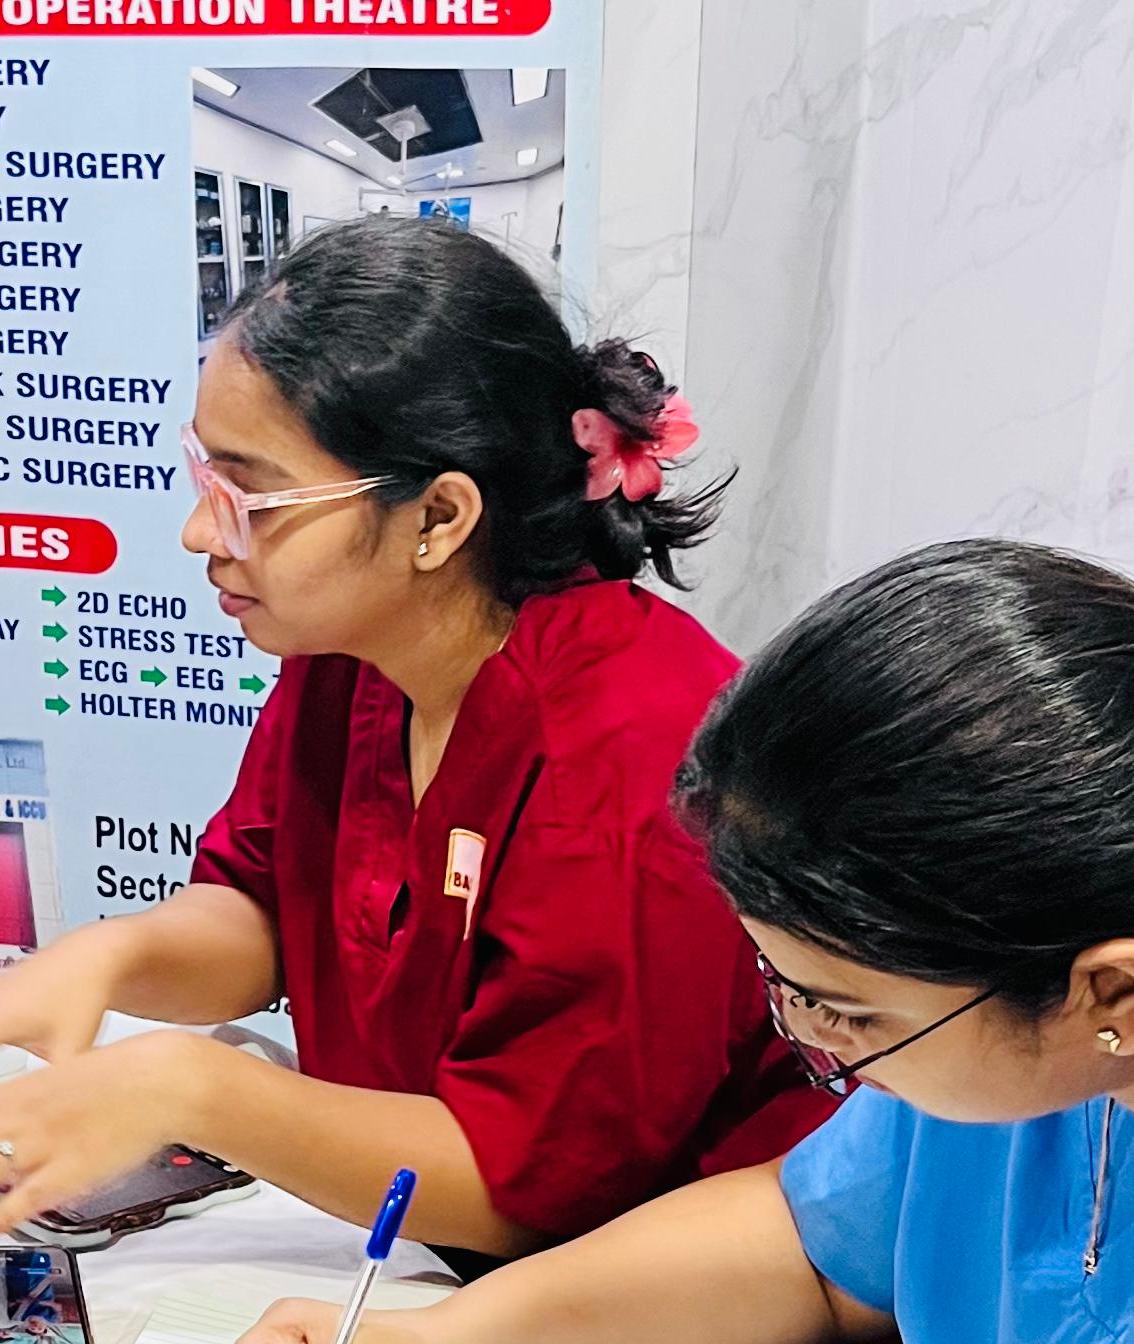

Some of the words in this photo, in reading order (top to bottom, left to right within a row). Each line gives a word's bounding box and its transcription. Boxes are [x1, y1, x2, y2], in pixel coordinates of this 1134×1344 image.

[5, 152, 166, 182] SURGERY
[16, 375, 171, 404] SURGERY
[5, 415, 161, 448] SURGERY
[22, 458, 176, 491] SURGERY
[77, 592, 108, 615] 2D
[119, 595, 186, 619] ECHO
[78, 626, 175, 653] STRESS
[184, 633, 246, 658] TEST
[79, 660, 128, 683] ECG
[176, 667, 224, 691] EEG
[80, 693, 176, 720] HOLTER
[95, 816, 158, 853] Plot
